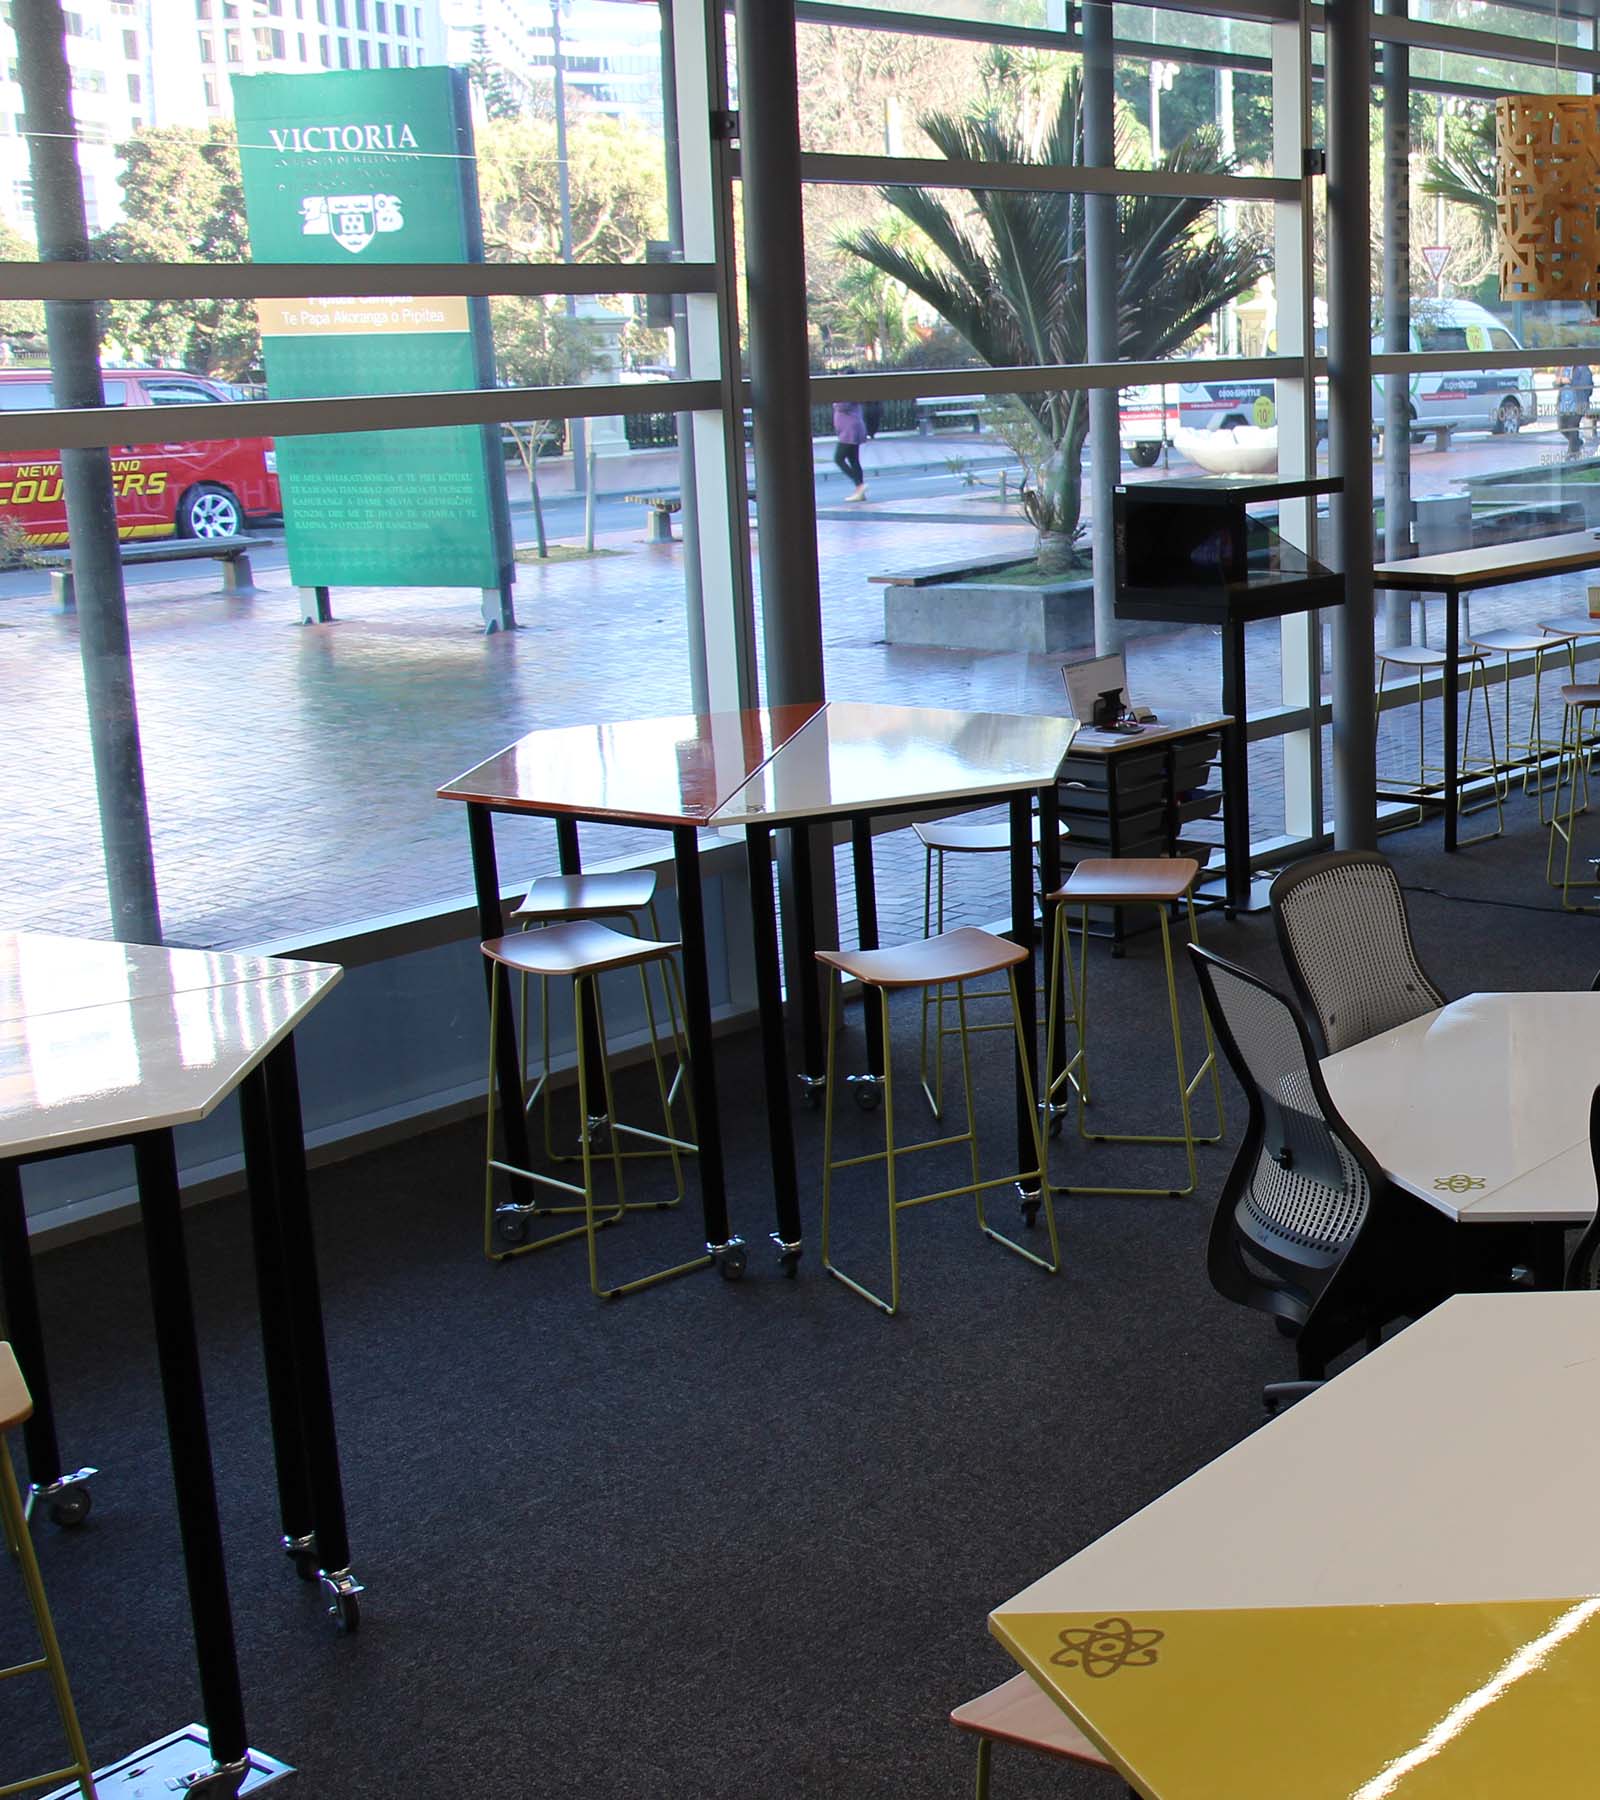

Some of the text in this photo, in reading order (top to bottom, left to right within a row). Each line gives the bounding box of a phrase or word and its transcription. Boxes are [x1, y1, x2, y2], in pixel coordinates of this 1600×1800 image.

[269, 123, 419, 153] VICTORIA
[282, 308, 445, 327] Te Papa Akoranga o Pipitea
[16, 464, 59, 478] NEW
[0, 471, 168, 505] COUERS
